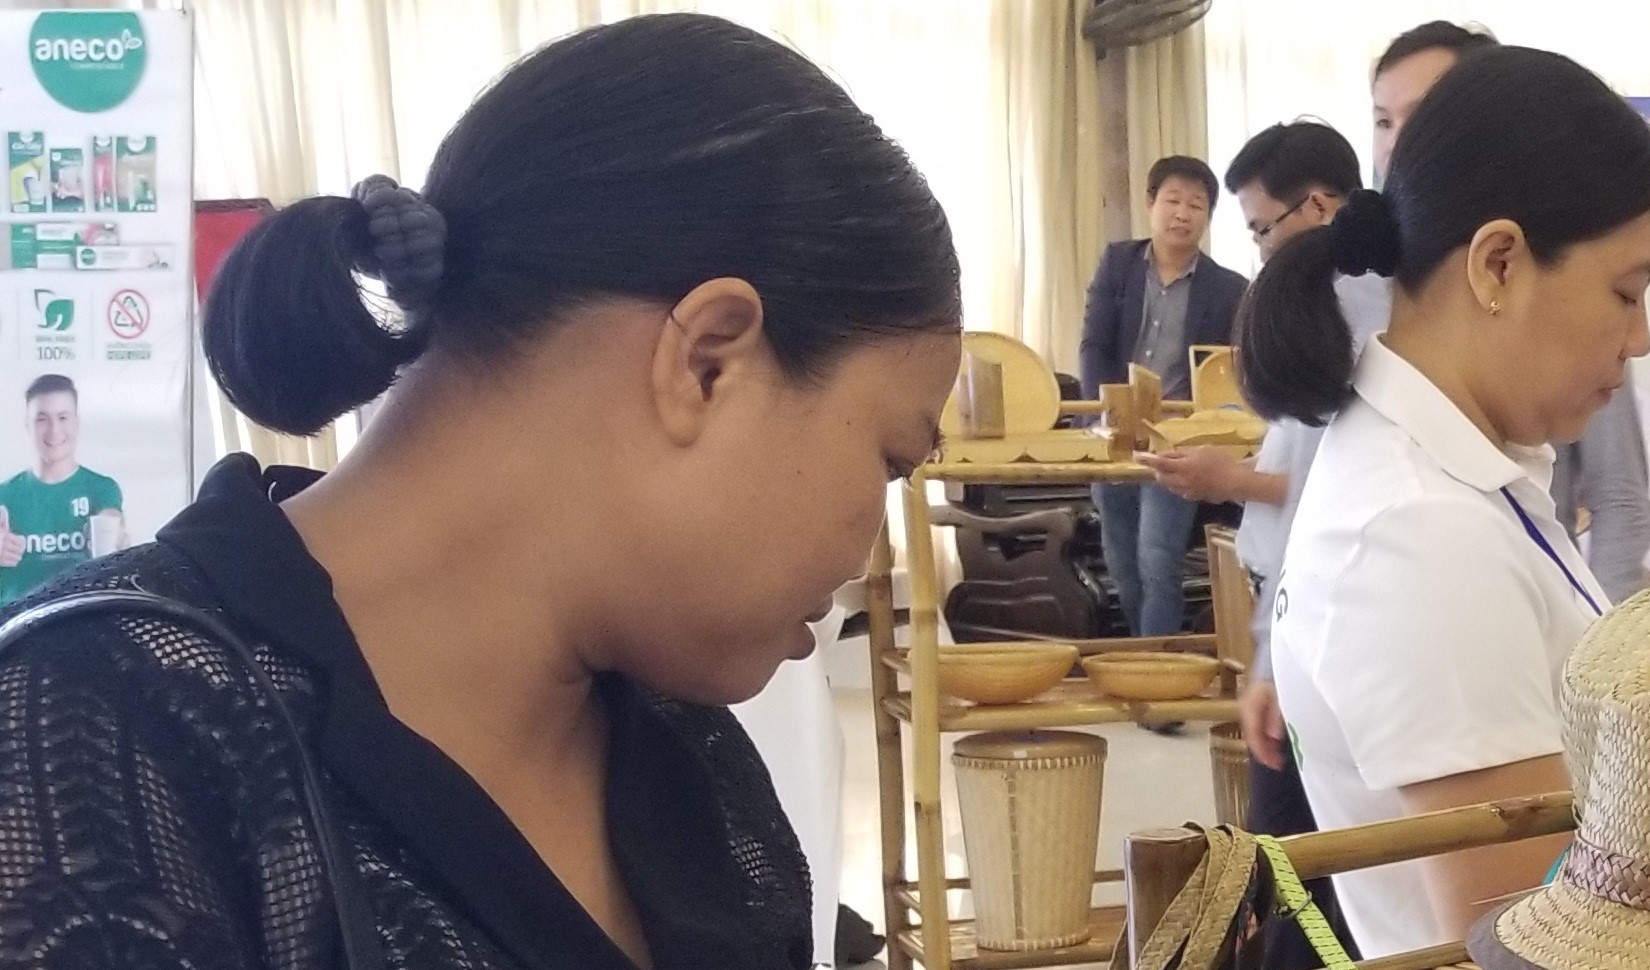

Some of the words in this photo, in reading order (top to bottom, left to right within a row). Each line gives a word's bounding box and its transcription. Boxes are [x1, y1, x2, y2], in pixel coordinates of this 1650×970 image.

[36, 38, 125, 61] aneco
[71, 497, 89, 516] 19
[26, 532, 85, 553] neco
